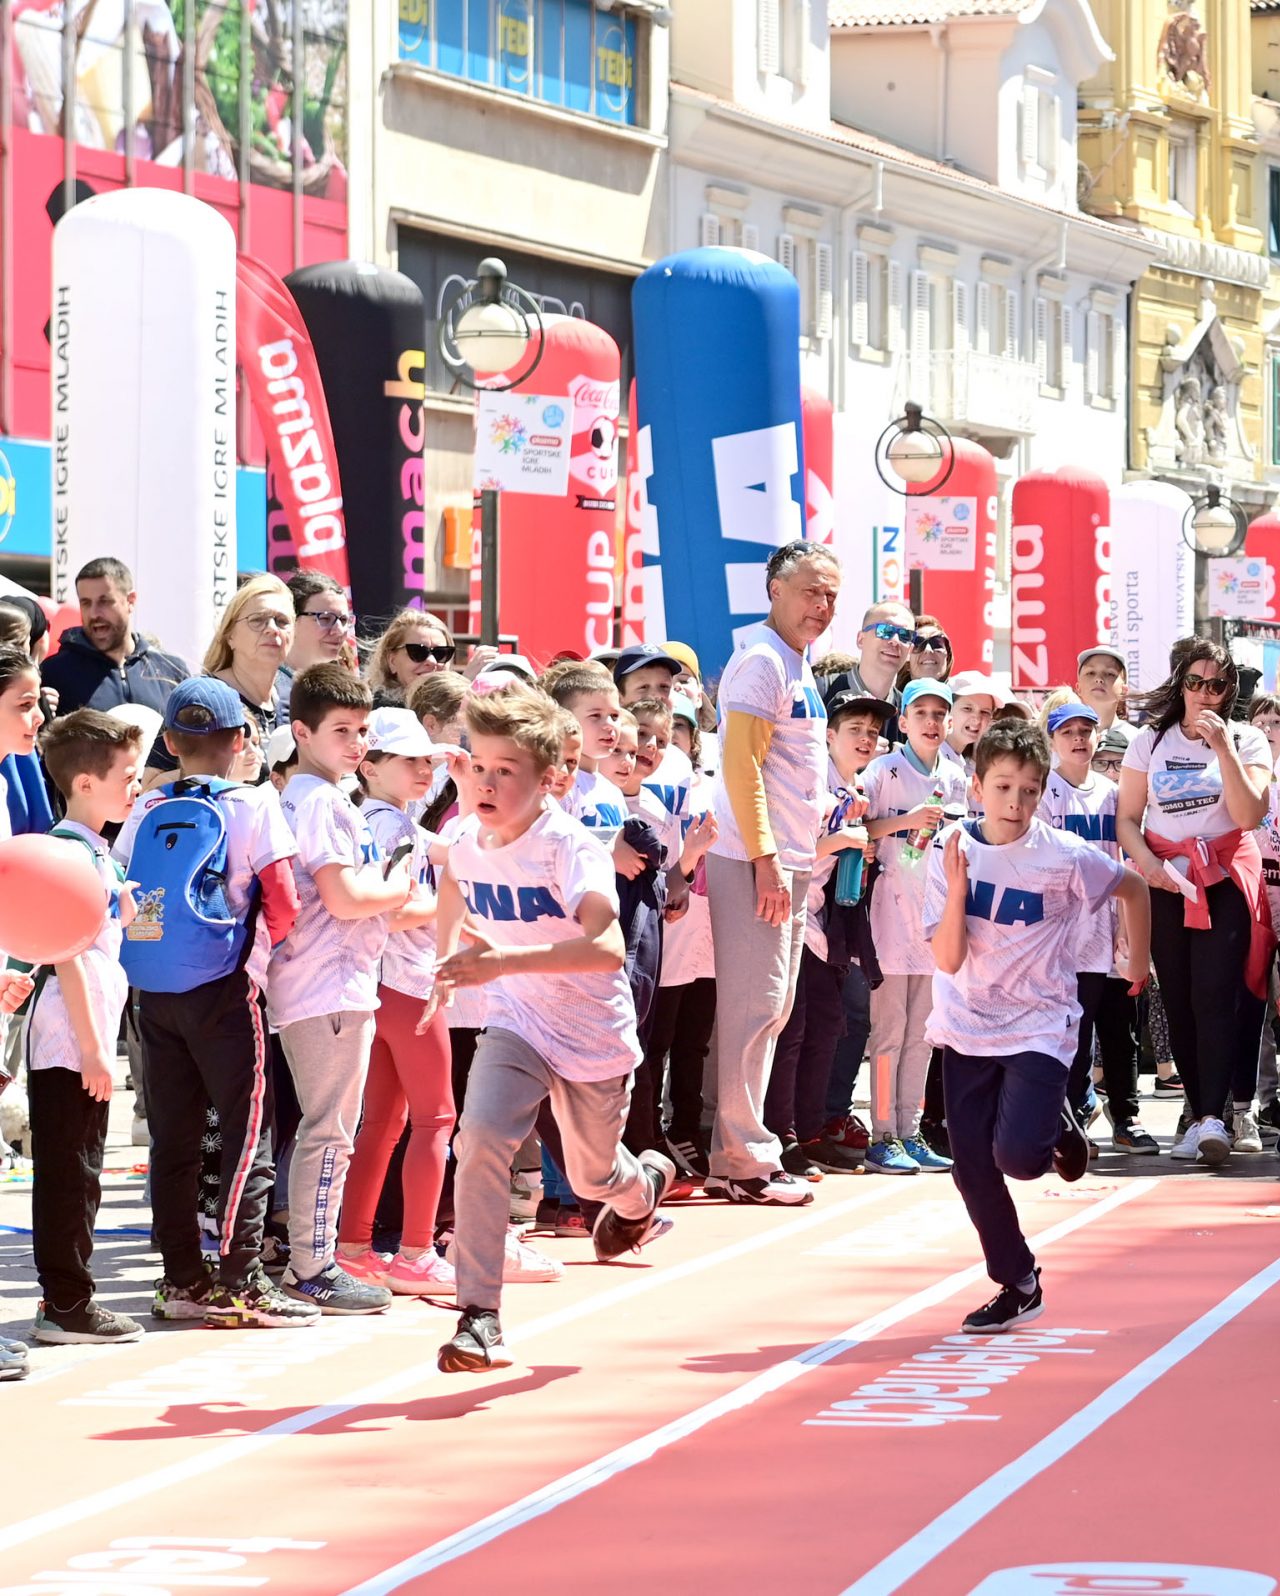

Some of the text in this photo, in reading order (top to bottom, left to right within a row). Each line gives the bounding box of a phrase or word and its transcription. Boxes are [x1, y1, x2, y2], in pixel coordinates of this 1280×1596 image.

[213, 290, 228, 416] MLADIH
[56, 285, 71, 604] RTSKE IGRE MLADIH
[213, 427, 228, 499] IGRE
[383, 348, 426, 592] mach
[585, 530, 615, 652] CUP
[1126, 570, 1144, 633] sporta
[300, 1282, 335, 1300] REPLAY
[801, 1327, 1109, 1427] telemach
